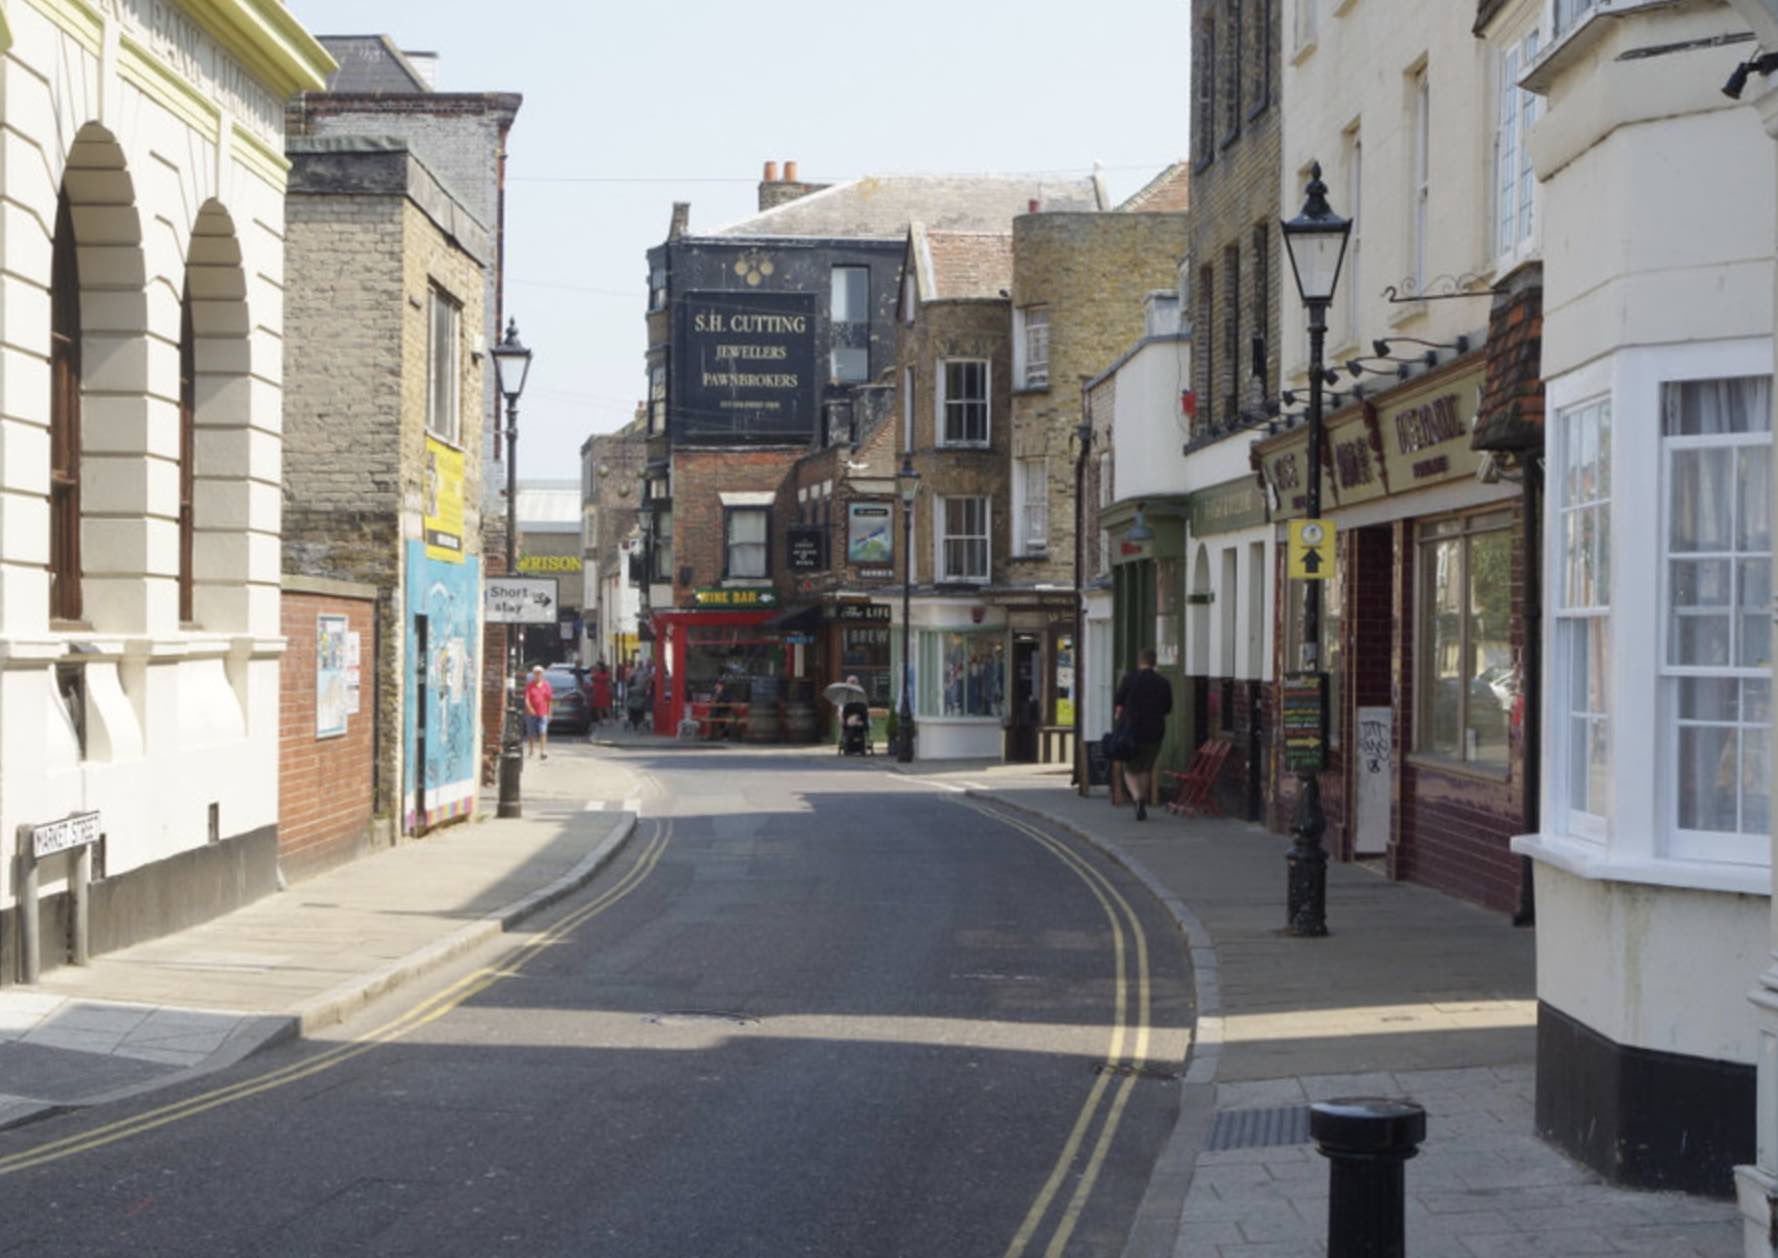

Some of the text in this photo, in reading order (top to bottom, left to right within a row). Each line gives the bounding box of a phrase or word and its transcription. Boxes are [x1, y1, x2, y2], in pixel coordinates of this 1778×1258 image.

[694, 314, 806, 333] S.H. CUTTING
[715, 344, 787, 361] JEWELLERS
[703, 372, 798, 388] PAWNBROKERS
[490, 585, 528, 598] Short
[699, 591, 757, 604] WINE BAR
[495, 602, 522, 615] stay
